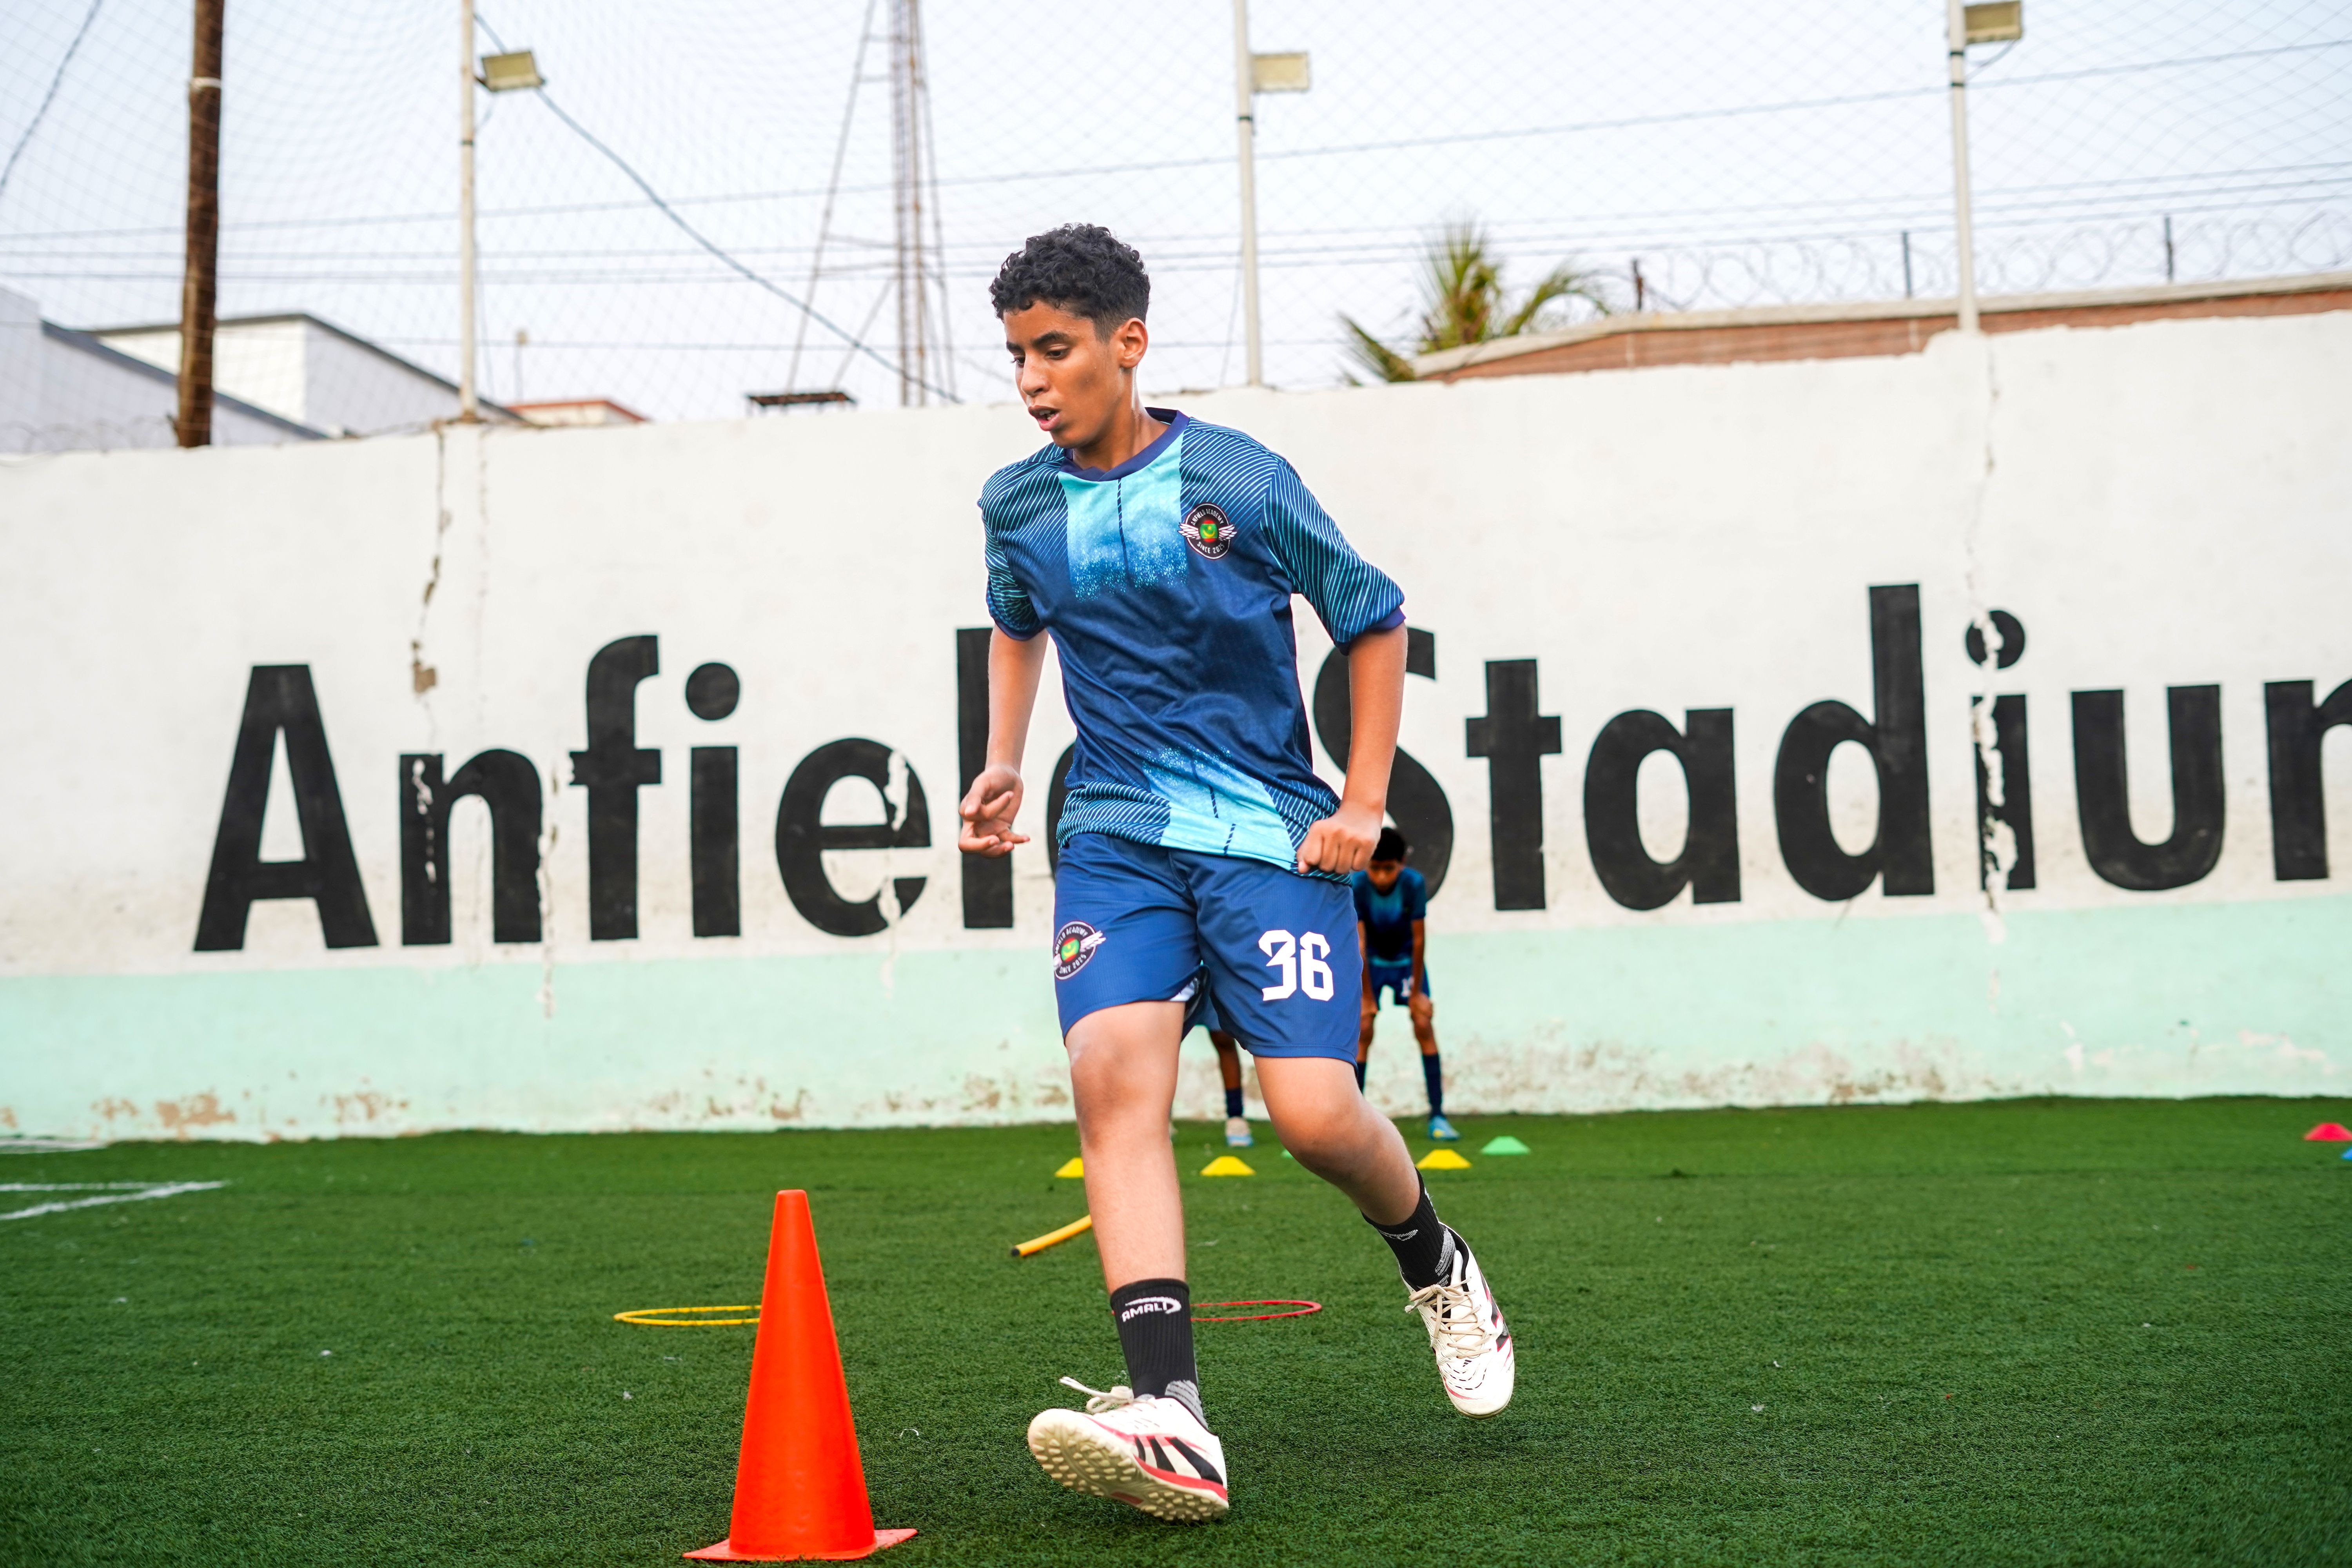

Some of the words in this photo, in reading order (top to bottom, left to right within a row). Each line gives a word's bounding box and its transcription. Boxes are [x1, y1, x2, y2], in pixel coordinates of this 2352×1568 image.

[1191, 509, 1206, 526] ANFIELD
[1205, 508, 1224, 524] ACADEMY
[1197, 541, 1210, 554] SINCE
[194, 628, 1076, 952] Anfiel
[1258, 929, 1334, 1002] 36
